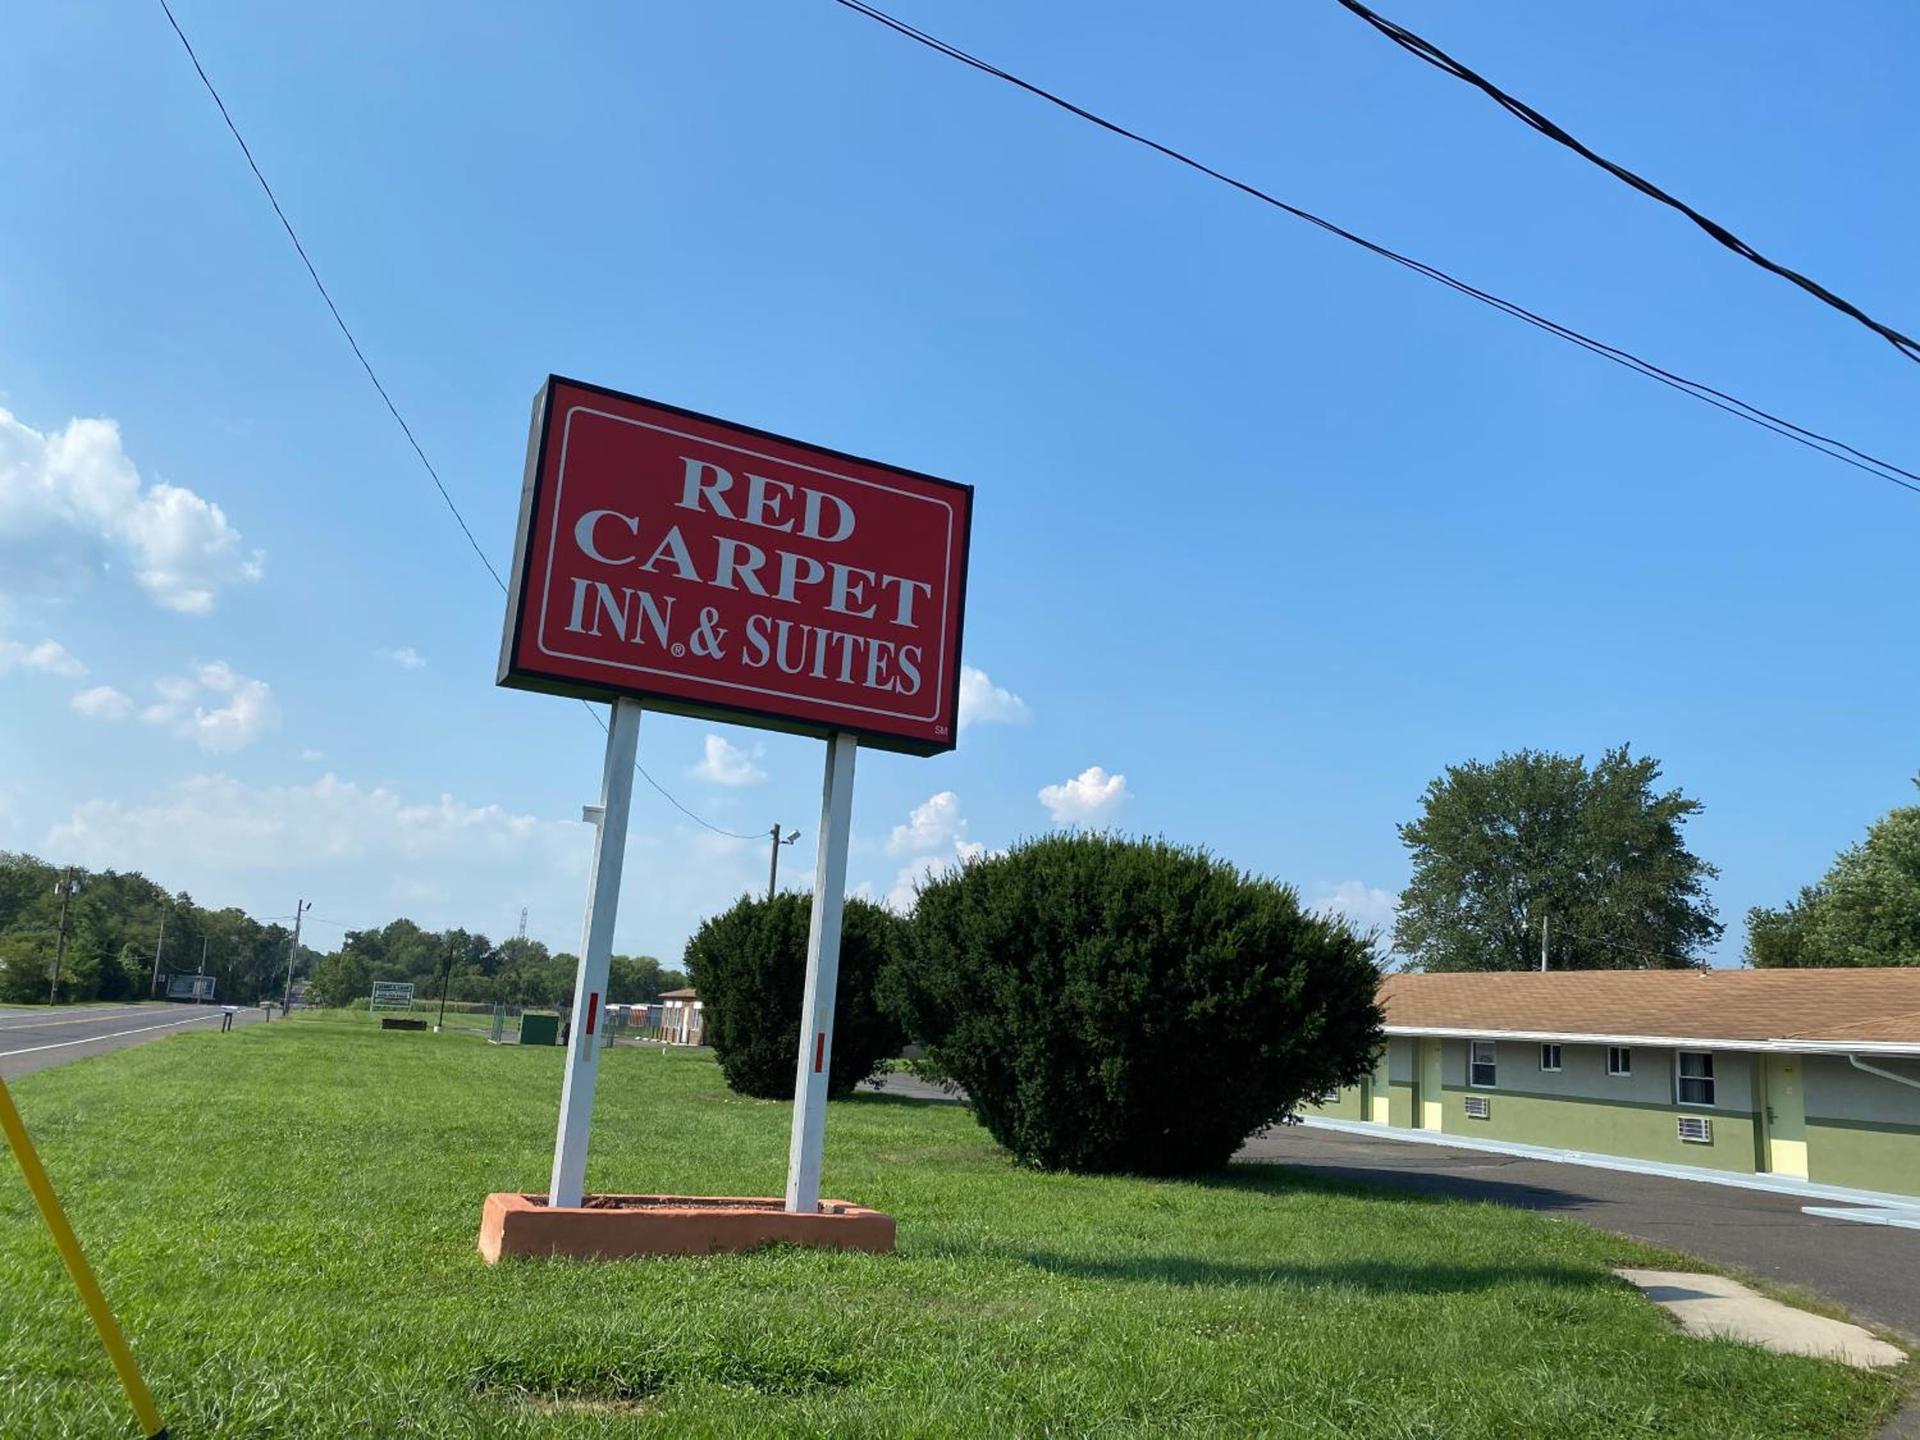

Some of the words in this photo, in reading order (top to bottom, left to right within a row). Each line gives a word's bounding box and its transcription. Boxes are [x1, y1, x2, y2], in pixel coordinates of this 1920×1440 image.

[674, 456, 856, 542] RED
[574, 510, 931, 628] CARPET
[689, 606, 728, 660] &
[742, 614, 922, 695] SUITES
